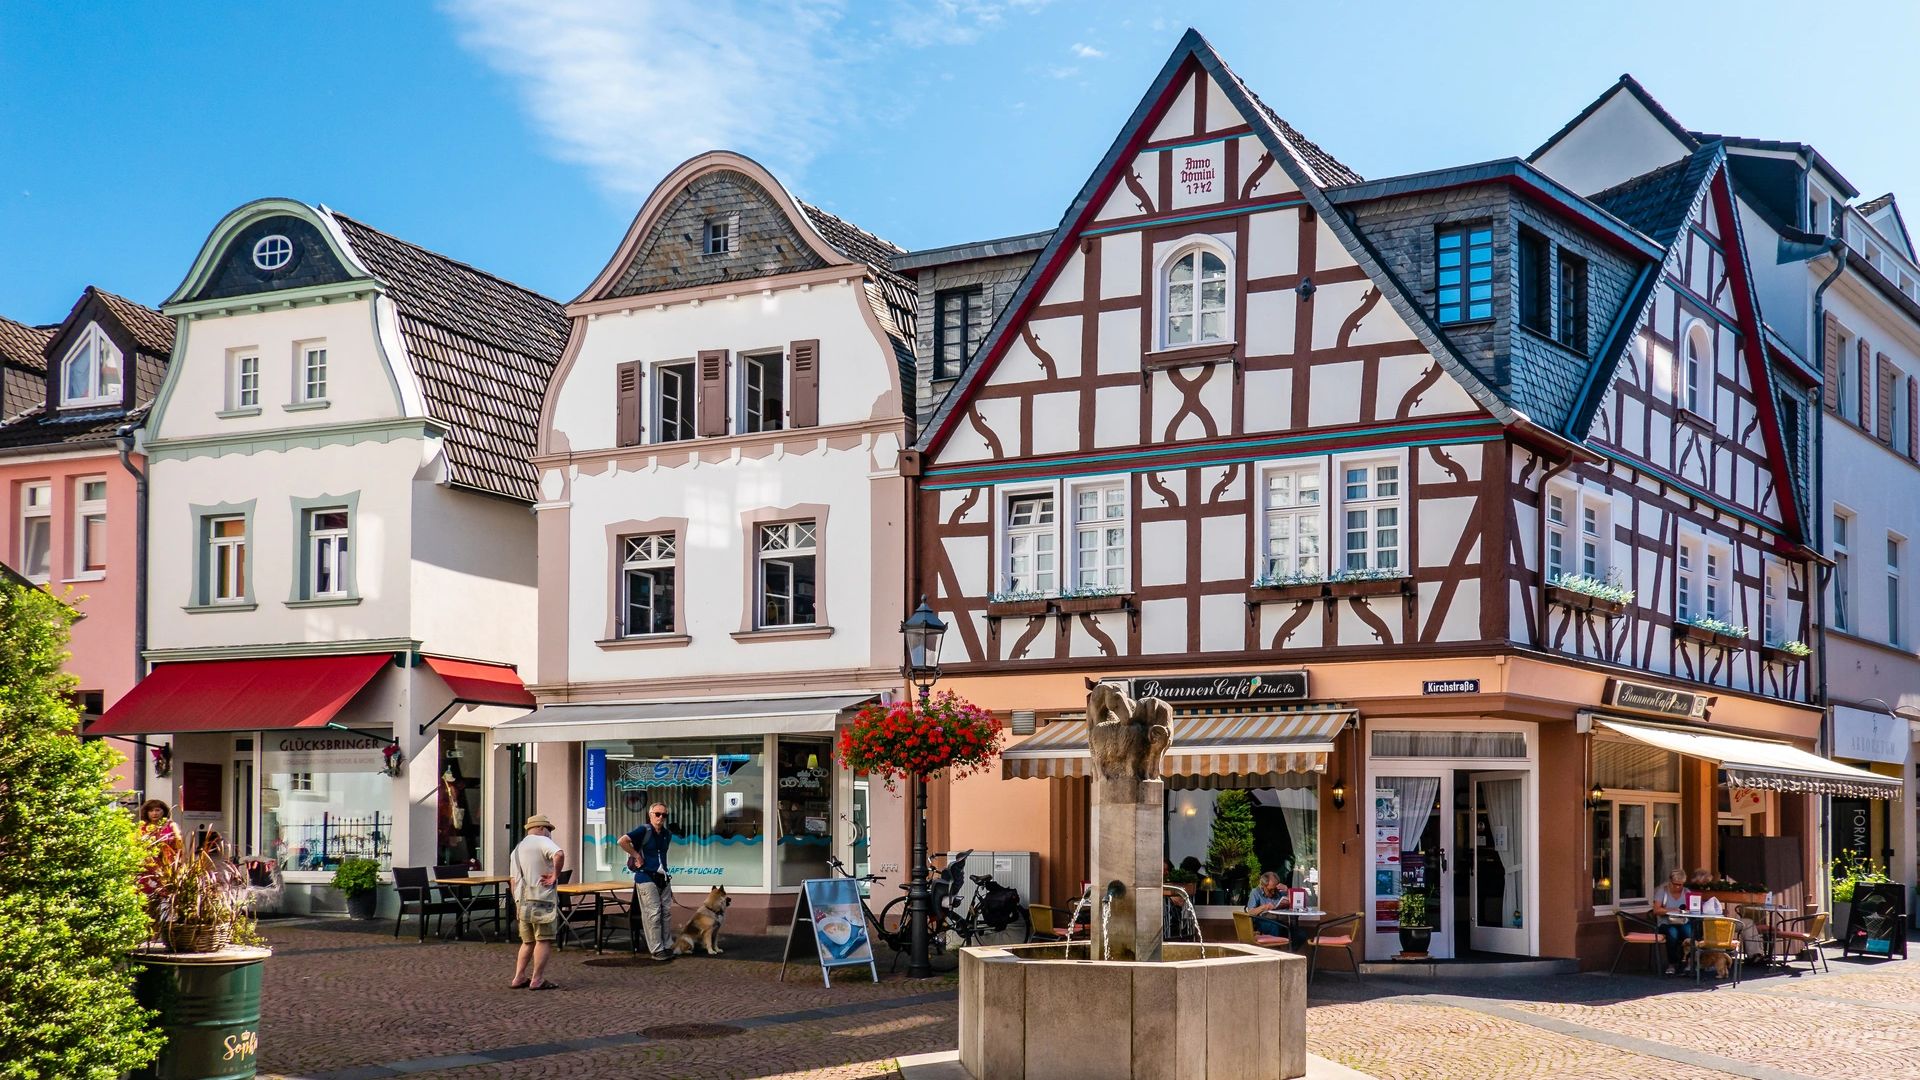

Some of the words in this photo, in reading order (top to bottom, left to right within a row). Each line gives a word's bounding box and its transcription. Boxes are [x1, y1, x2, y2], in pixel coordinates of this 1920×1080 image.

[1185, 157, 1211, 170] Anno
[1180, 168, 1216, 183] Domini
[1186, 181, 1212, 194] 1742
[1427, 681, 1474, 692] Kirchstraße
[280, 738, 379, 751] GLÜCKSBRINGER
[1854, 809, 1866, 846] FORM
